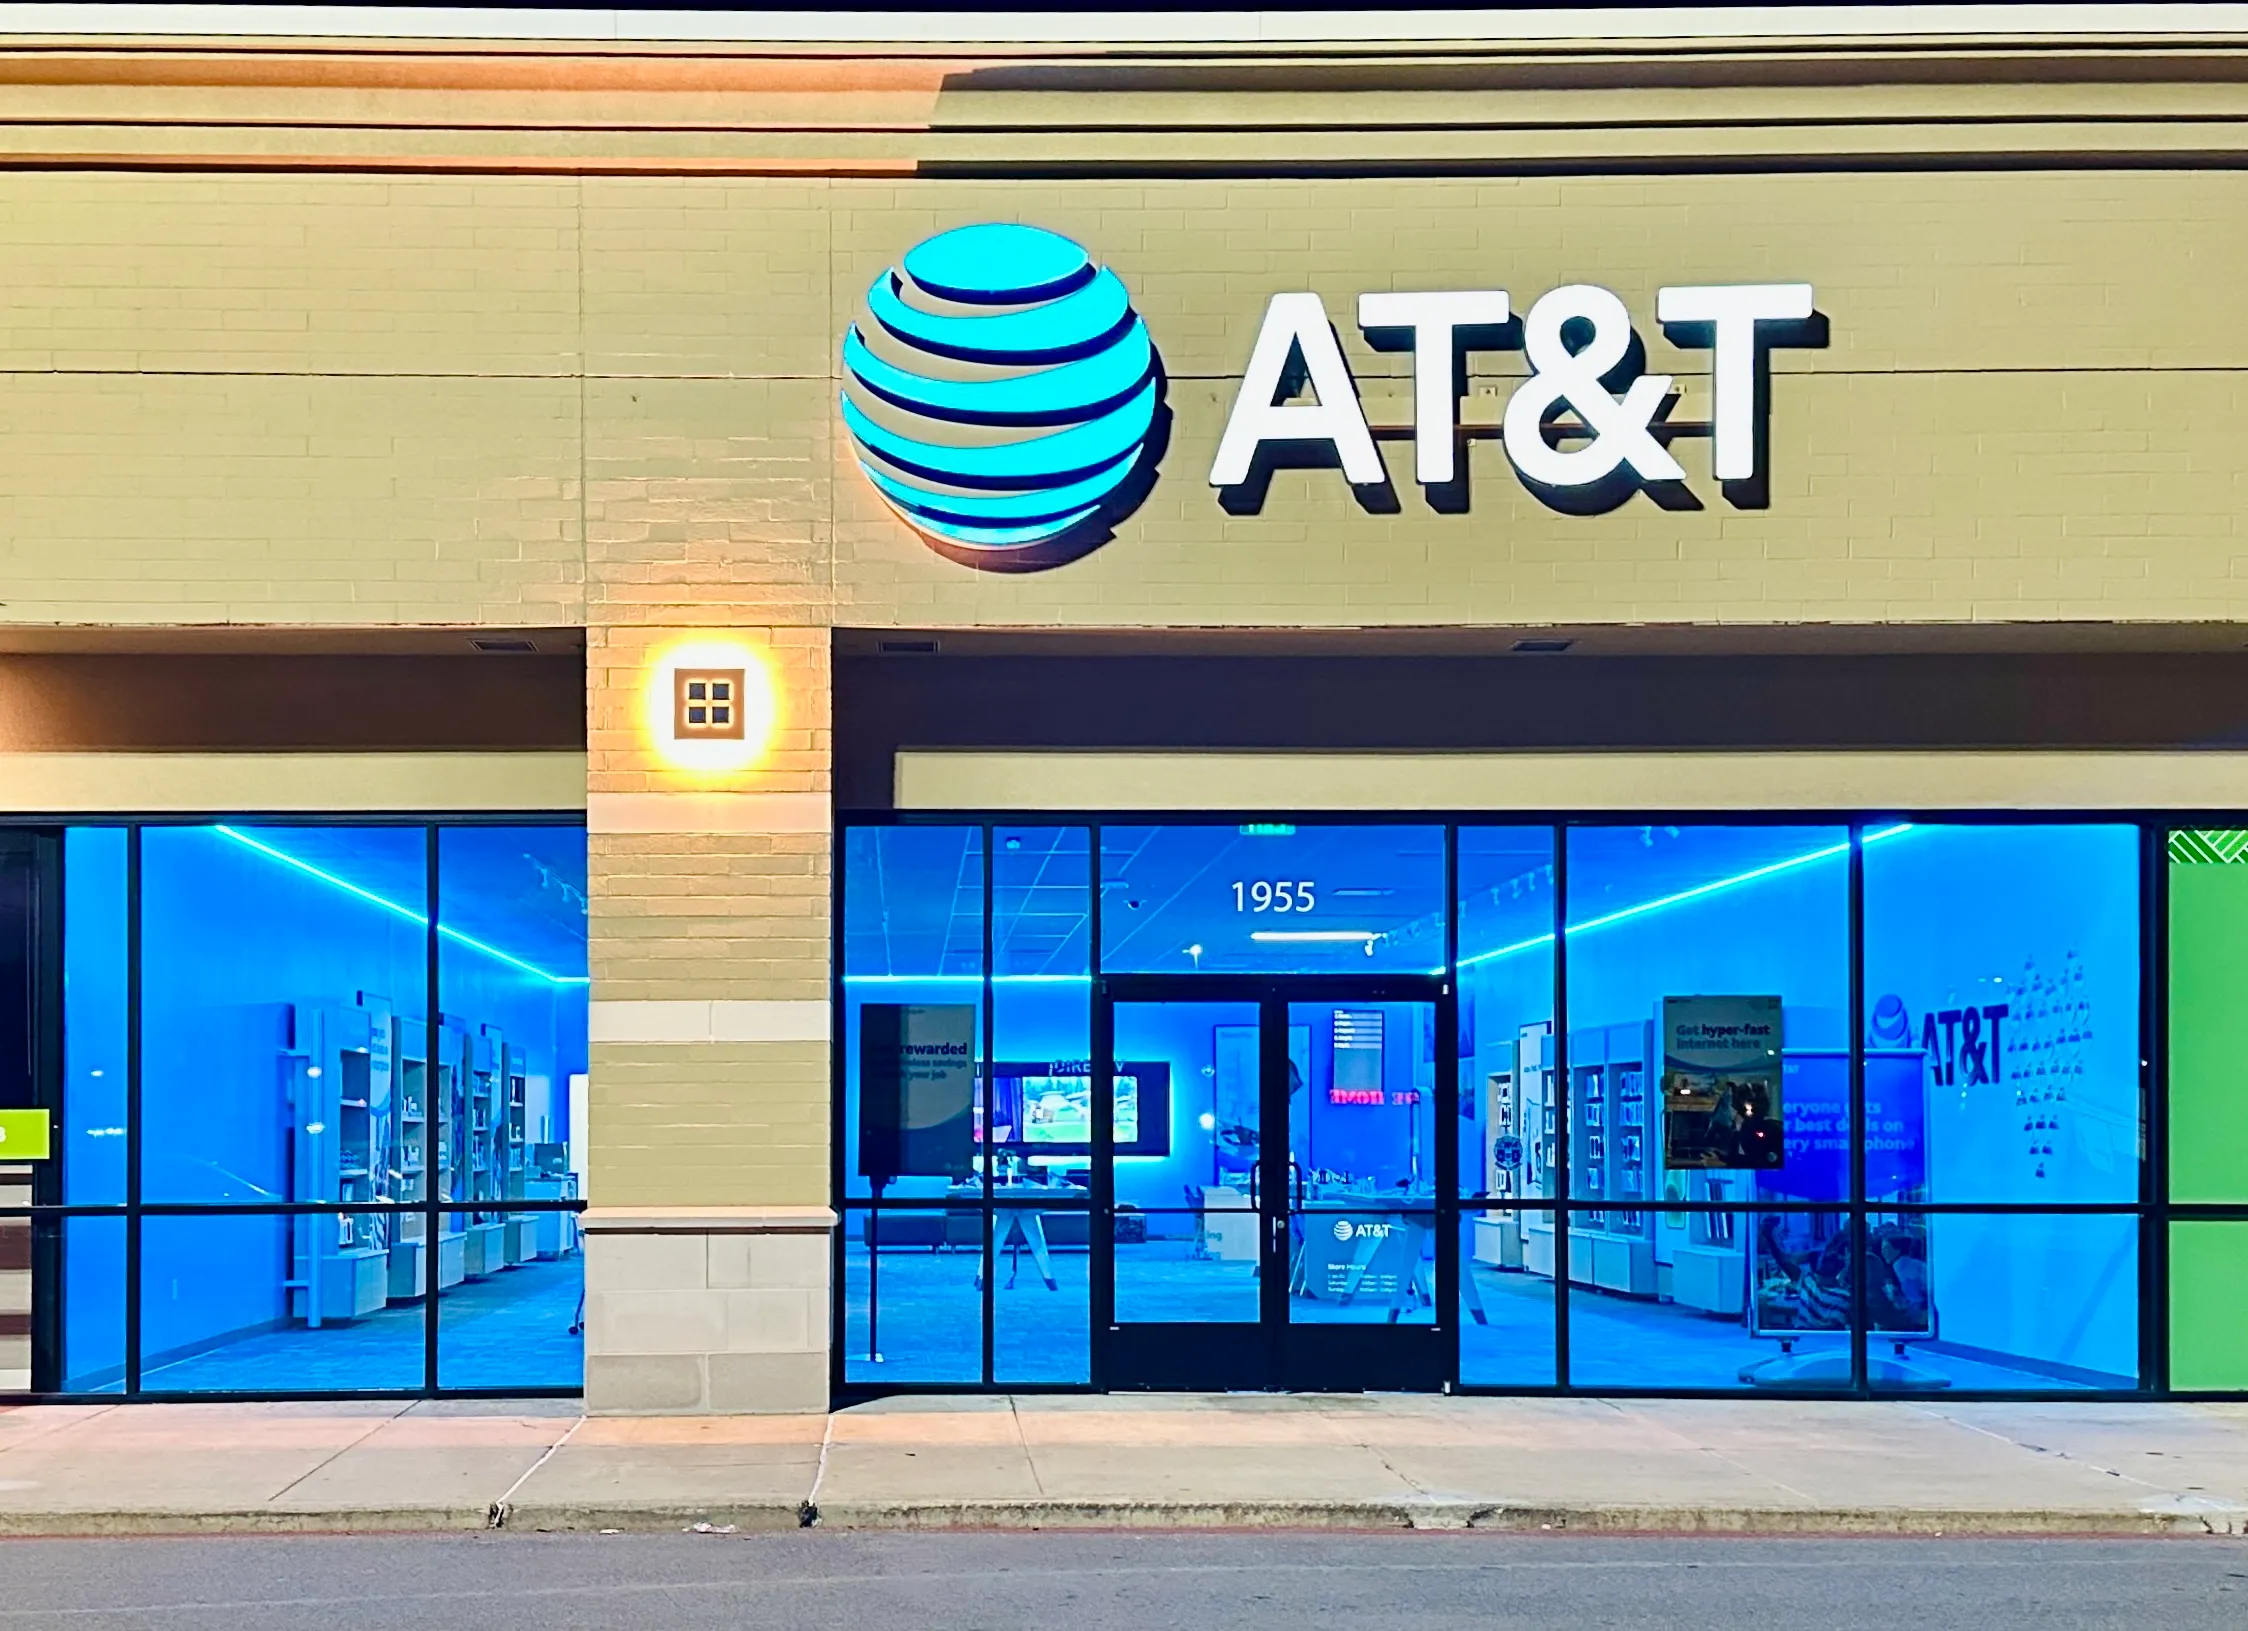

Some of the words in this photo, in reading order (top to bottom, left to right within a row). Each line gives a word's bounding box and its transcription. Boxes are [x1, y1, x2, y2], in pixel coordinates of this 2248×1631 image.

[1209, 284, 1814, 487] AT&T
[1232, 881, 1315, 912] 1955
[1676, 1024, 1700, 1035] Get
[1702, 1023, 1770, 1037] hyper-fast
[1731, 1037, 1761, 1049] here
[1921, 1004, 2009, 1086] AT&T
[1054, 1059, 1125, 1073] DIREV
[1782, 1102, 1841, 1117] eryone
[1795, 1117, 1832, 1132] best
[1882, 1120, 1904, 1132] on
[1783, 1138, 1810, 1153] ery
[1355, 1224, 1390, 1237] AT&T
